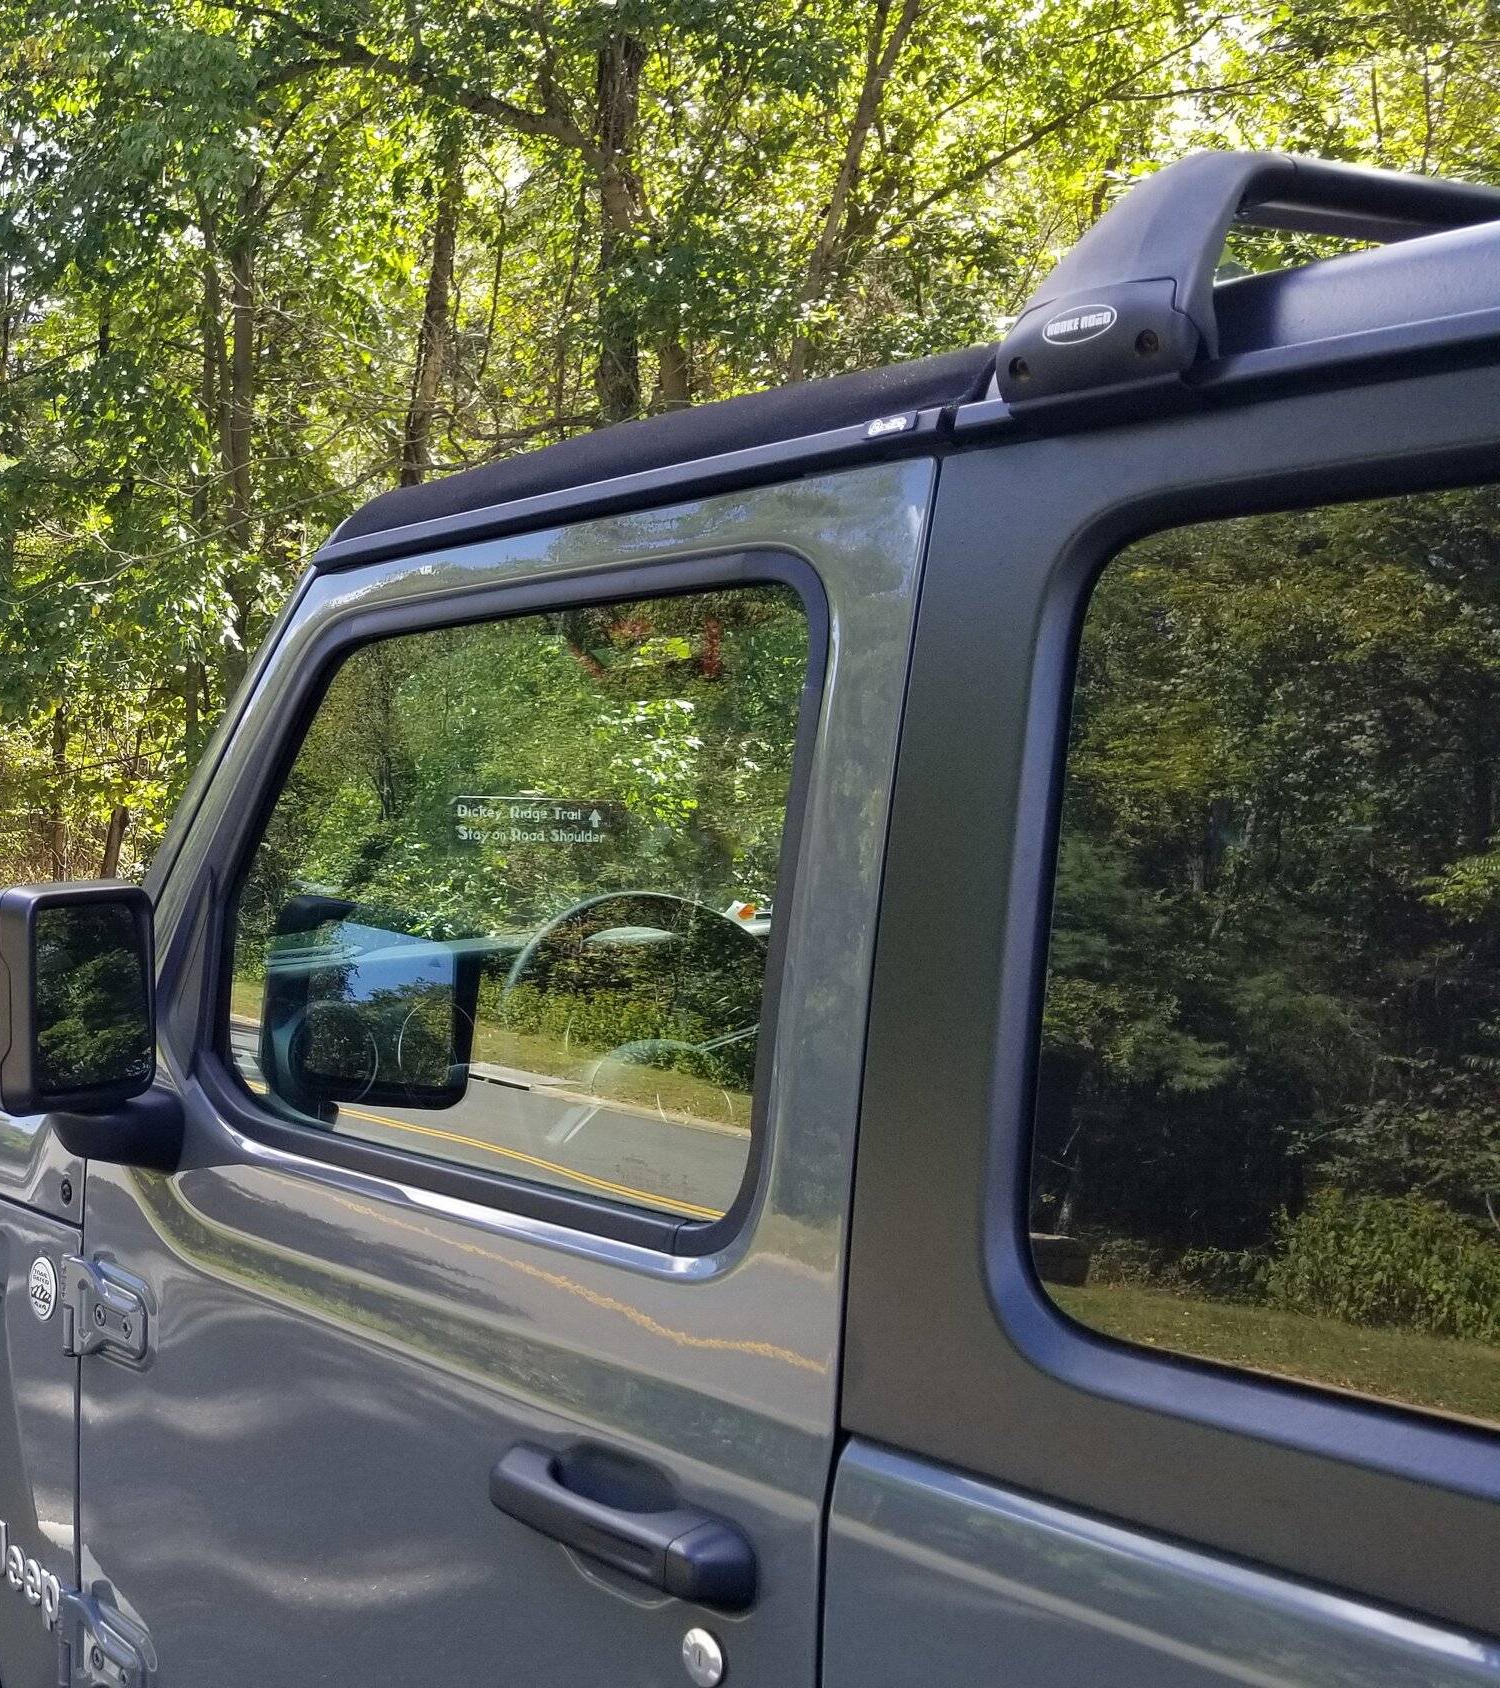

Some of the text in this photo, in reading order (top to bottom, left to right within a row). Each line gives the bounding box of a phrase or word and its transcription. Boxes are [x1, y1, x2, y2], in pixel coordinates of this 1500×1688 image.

[457, 804, 581, 823] Dickey Ridge Trail
[457, 825, 605, 844] Stay on Road Shoulder
